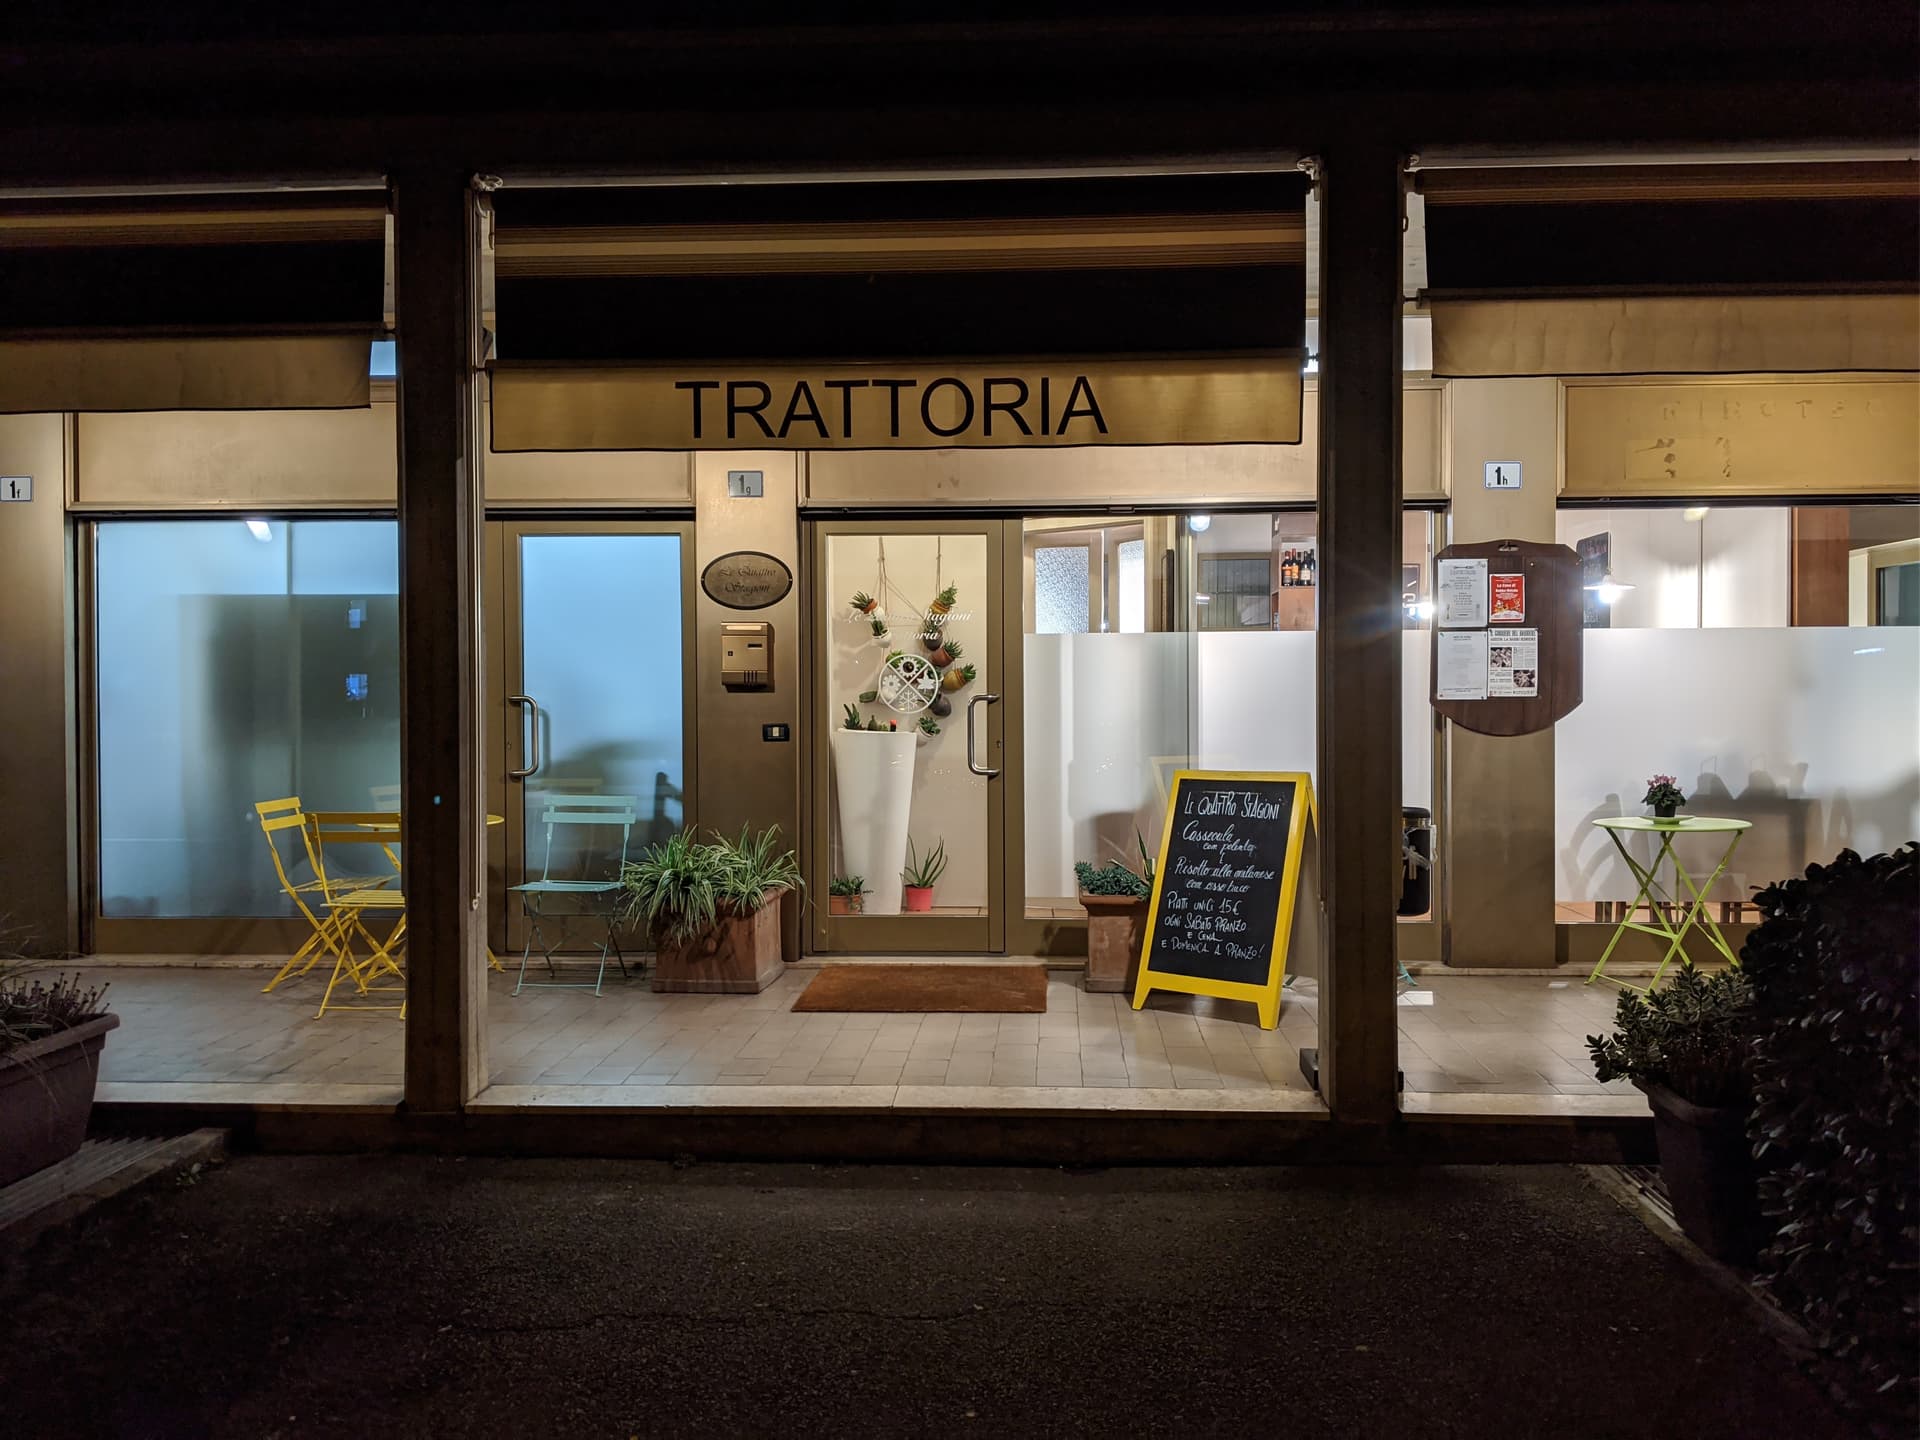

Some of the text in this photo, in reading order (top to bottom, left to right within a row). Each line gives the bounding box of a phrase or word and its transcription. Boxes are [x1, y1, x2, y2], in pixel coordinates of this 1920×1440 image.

[675, 375, 1109, 440] TRATTORIA
[1495, 466, 1508, 485] 1h
[1174, 856, 1211, 876] Risotto
[1214, 916, 1247, 933] PRANZO
